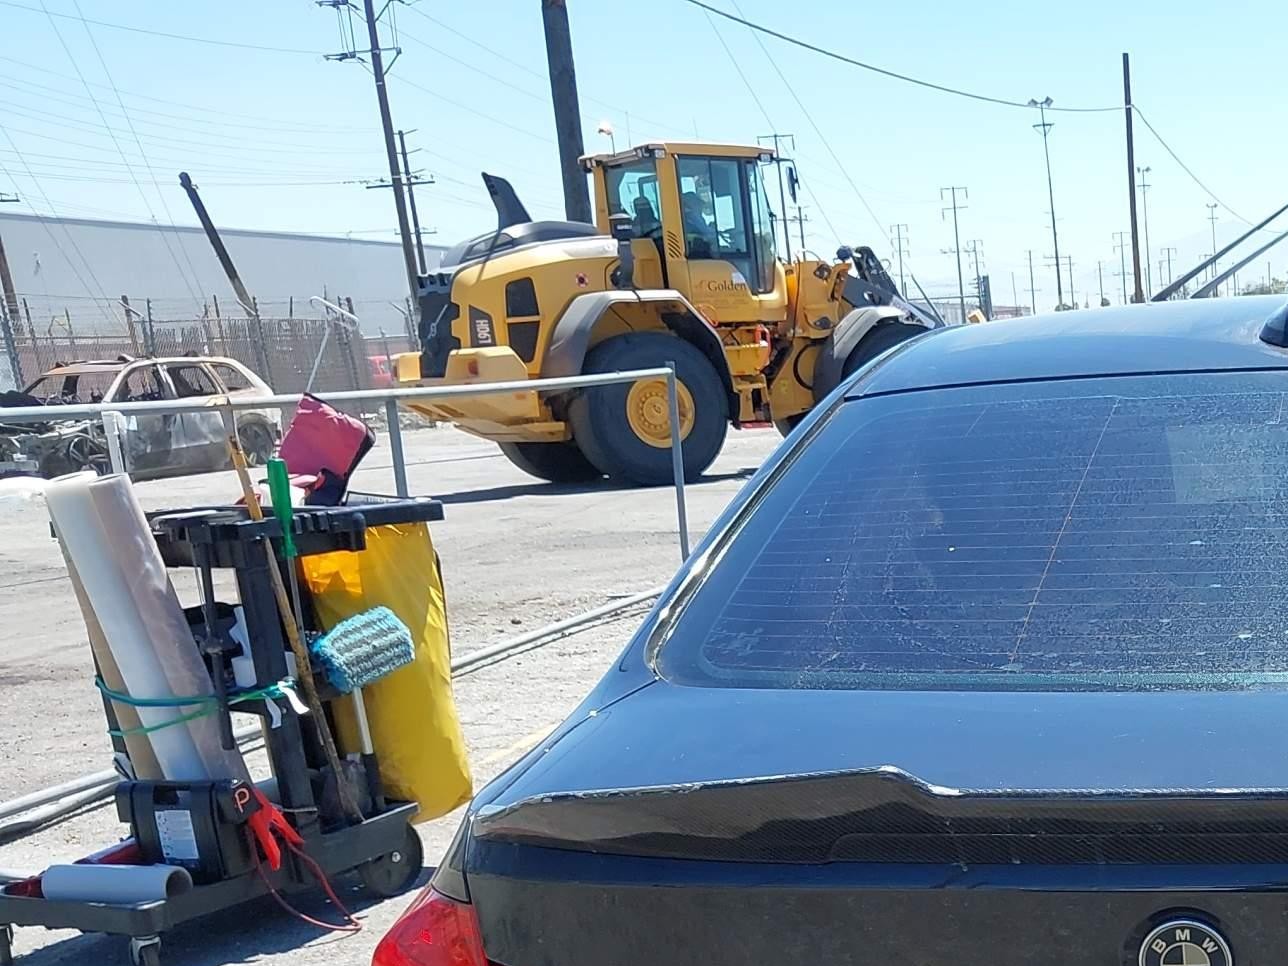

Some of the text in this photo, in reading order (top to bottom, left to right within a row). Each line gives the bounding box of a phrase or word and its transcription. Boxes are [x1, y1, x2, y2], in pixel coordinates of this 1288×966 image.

[707, 280, 746, 291] Golden
[475, 319, 492, 344] L90H
[1150, 928, 1219, 955] BMW
